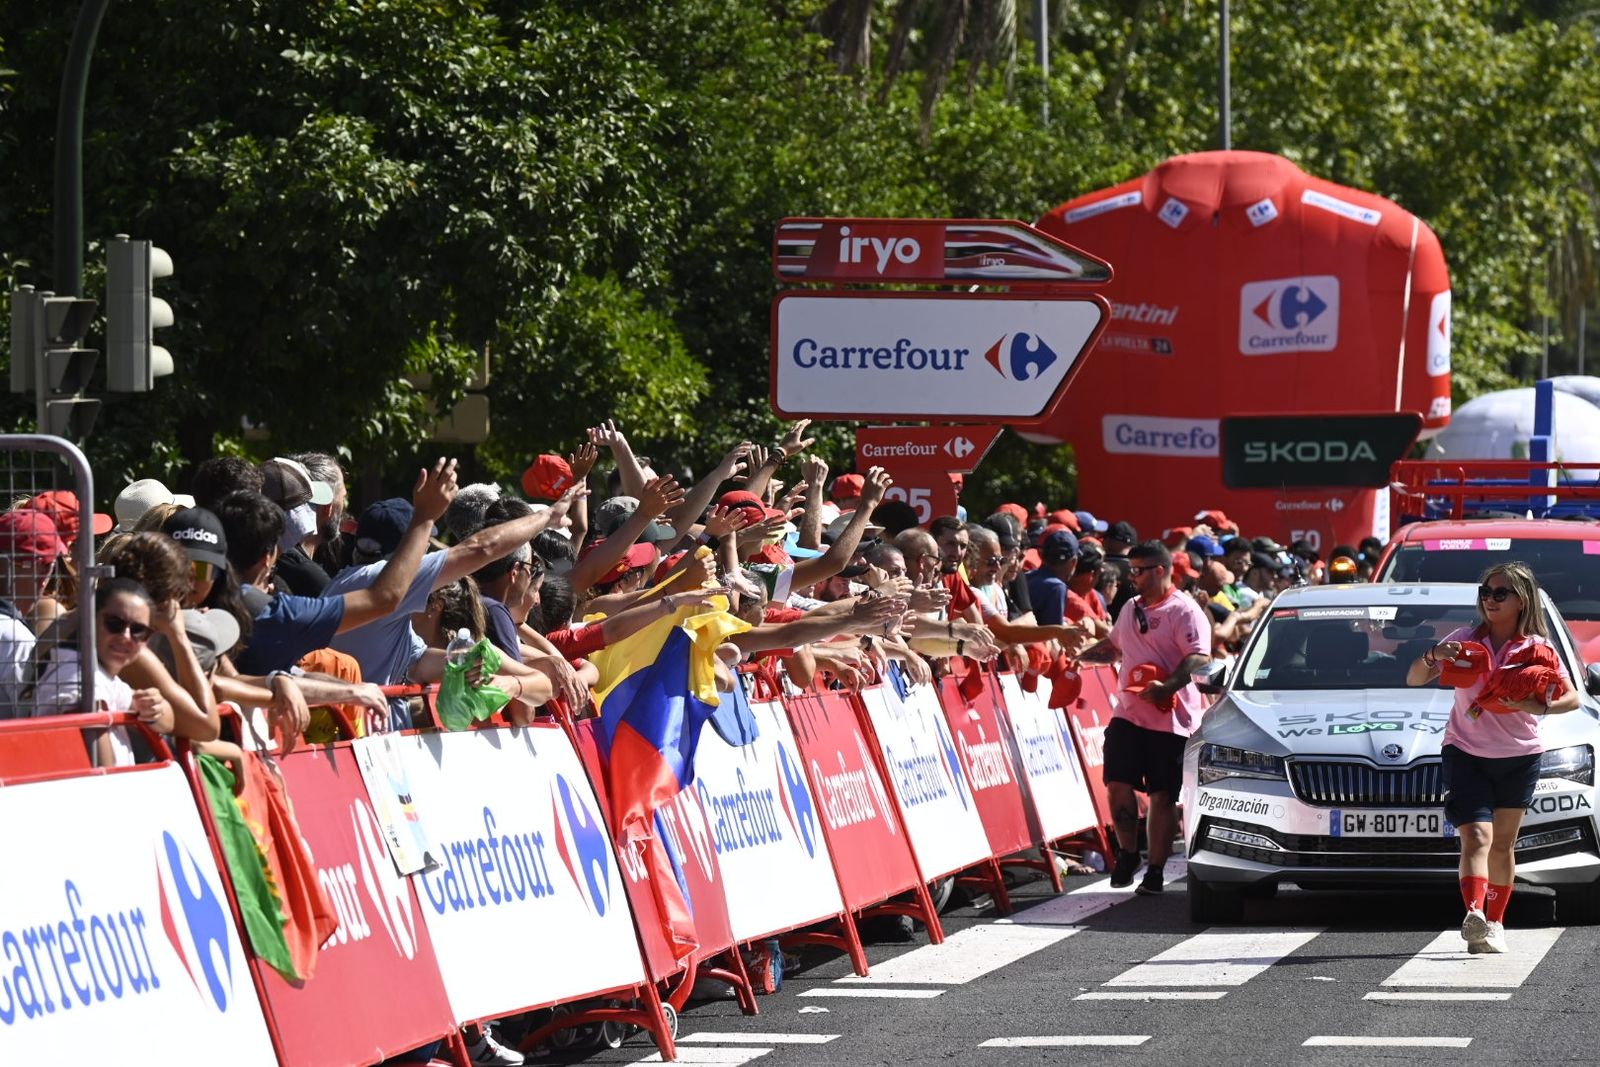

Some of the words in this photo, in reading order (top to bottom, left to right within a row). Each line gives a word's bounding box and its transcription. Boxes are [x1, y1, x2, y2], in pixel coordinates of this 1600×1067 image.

[839, 226, 921, 274] iryo
[1110, 303, 1179, 325] antini
[1249, 332, 1328, 349] Carrefour
[793, 338, 969, 370] Carrefour
[1115, 424, 1217, 449] Carrefo
[862, 442, 937, 457] Carrefour
[1244, 441, 1377, 463] SKODA
[172, 528, 218, 544] adidas
[1278, 710, 1450, 726] SKOD
[1277, 727, 1323, 738] We
[885, 736, 948, 808] Carrefour
[812, 750, 876, 830] Carrefour
[1536, 782, 1558, 791] BRID
[696, 767, 783, 855] Carrefour
[1199, 791, 1269, 815] Organización
[1524, 793, 1592, 816] KODA
[1443, 825, 1455, 835] 02
